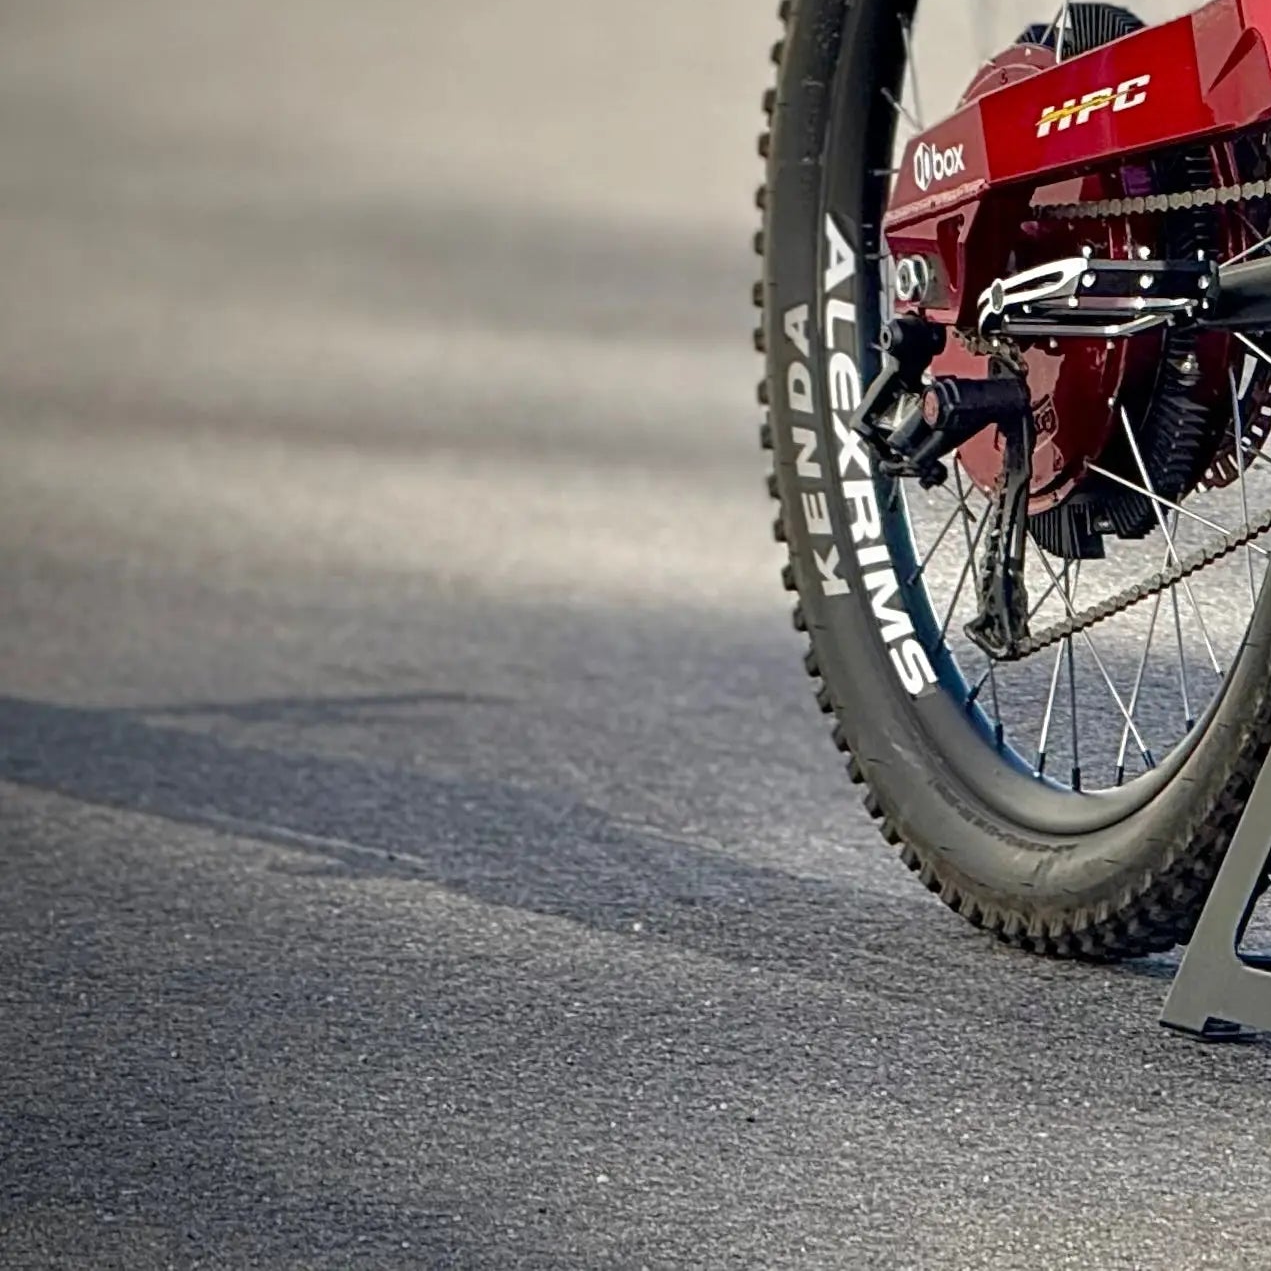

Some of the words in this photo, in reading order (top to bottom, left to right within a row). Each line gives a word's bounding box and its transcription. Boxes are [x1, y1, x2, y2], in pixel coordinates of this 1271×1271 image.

[932, 143, 966, 180] box
[1036, 74, 1151, 138] HPC
[785, 303, 852, 598] KENDA
[824, 212, 938, 697] ALEXRIMS
